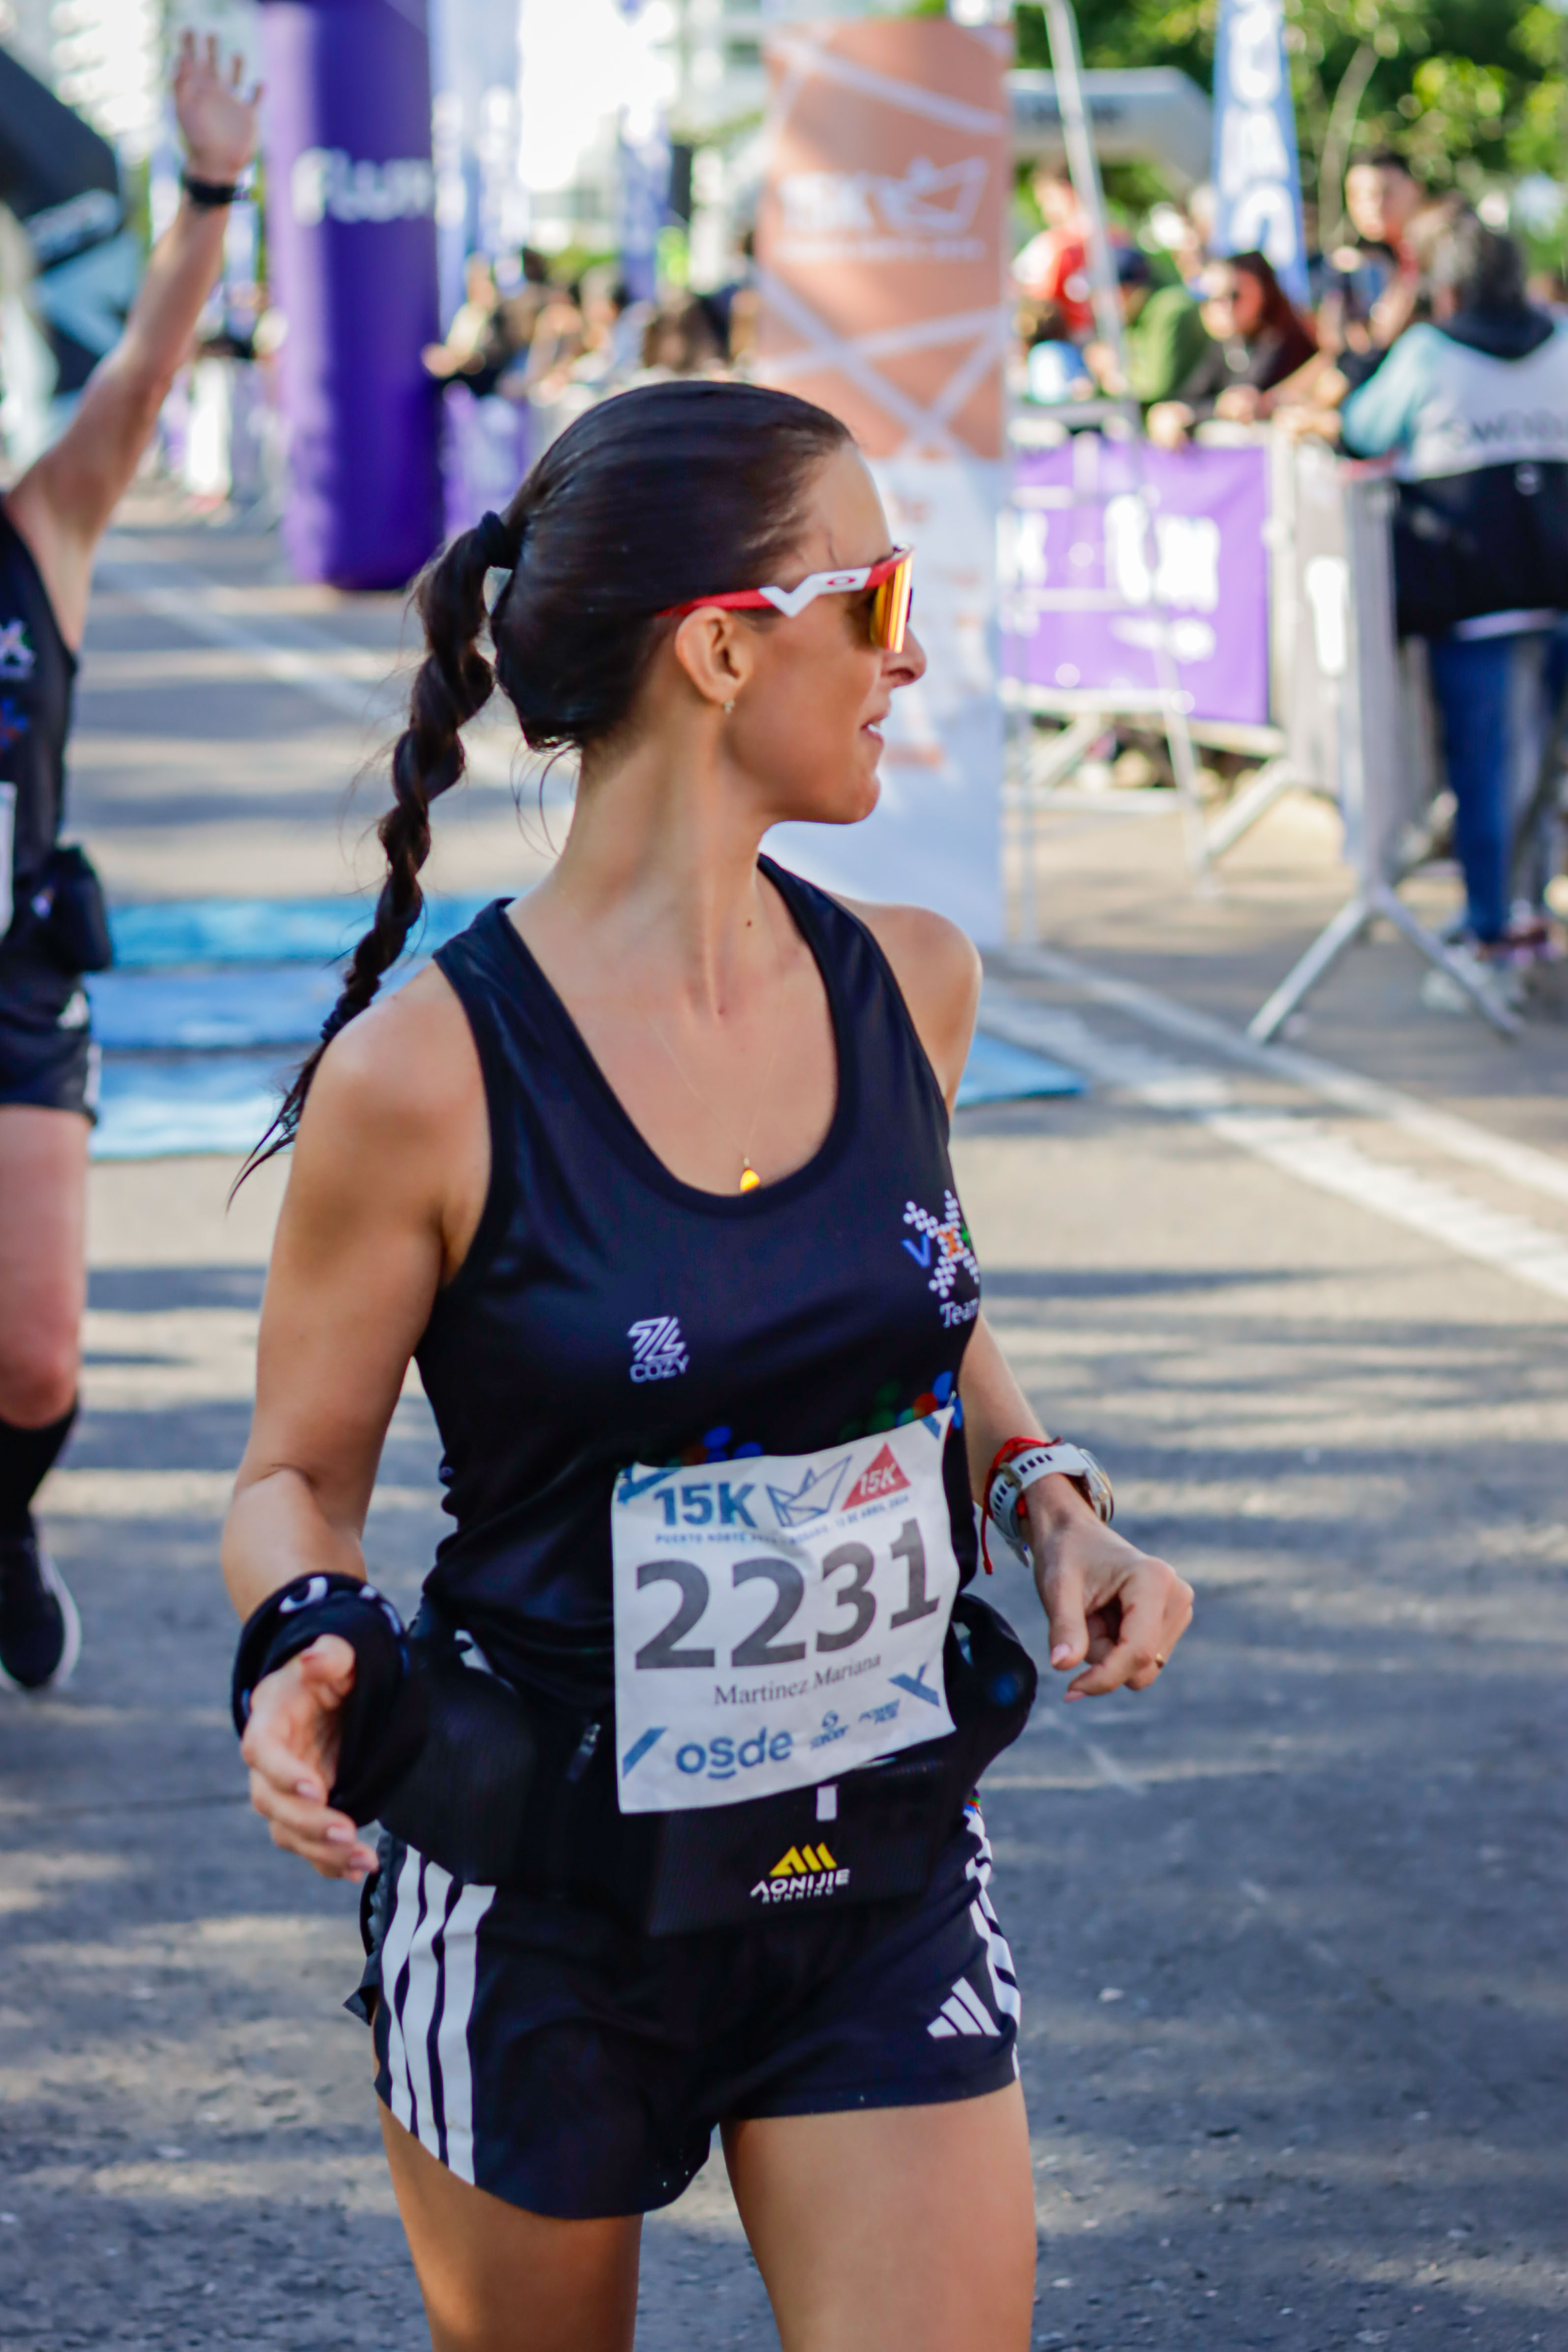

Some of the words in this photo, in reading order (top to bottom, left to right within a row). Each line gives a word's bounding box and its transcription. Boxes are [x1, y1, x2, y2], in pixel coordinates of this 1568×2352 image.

[630, 1354, 689, 1383] COZY
[859, 1462, 897, 1496] 15K
[653, 1481, 758, 1528] 15K
[635, 1518, 941, 1670] 2231
[714, 1678, 808, 1705] Martinez
[812, 1653, 882, 1690] Mariana
[676, 1725, 793, 1776] osde
[750, 1868, 850, 1897] AONIJIE
